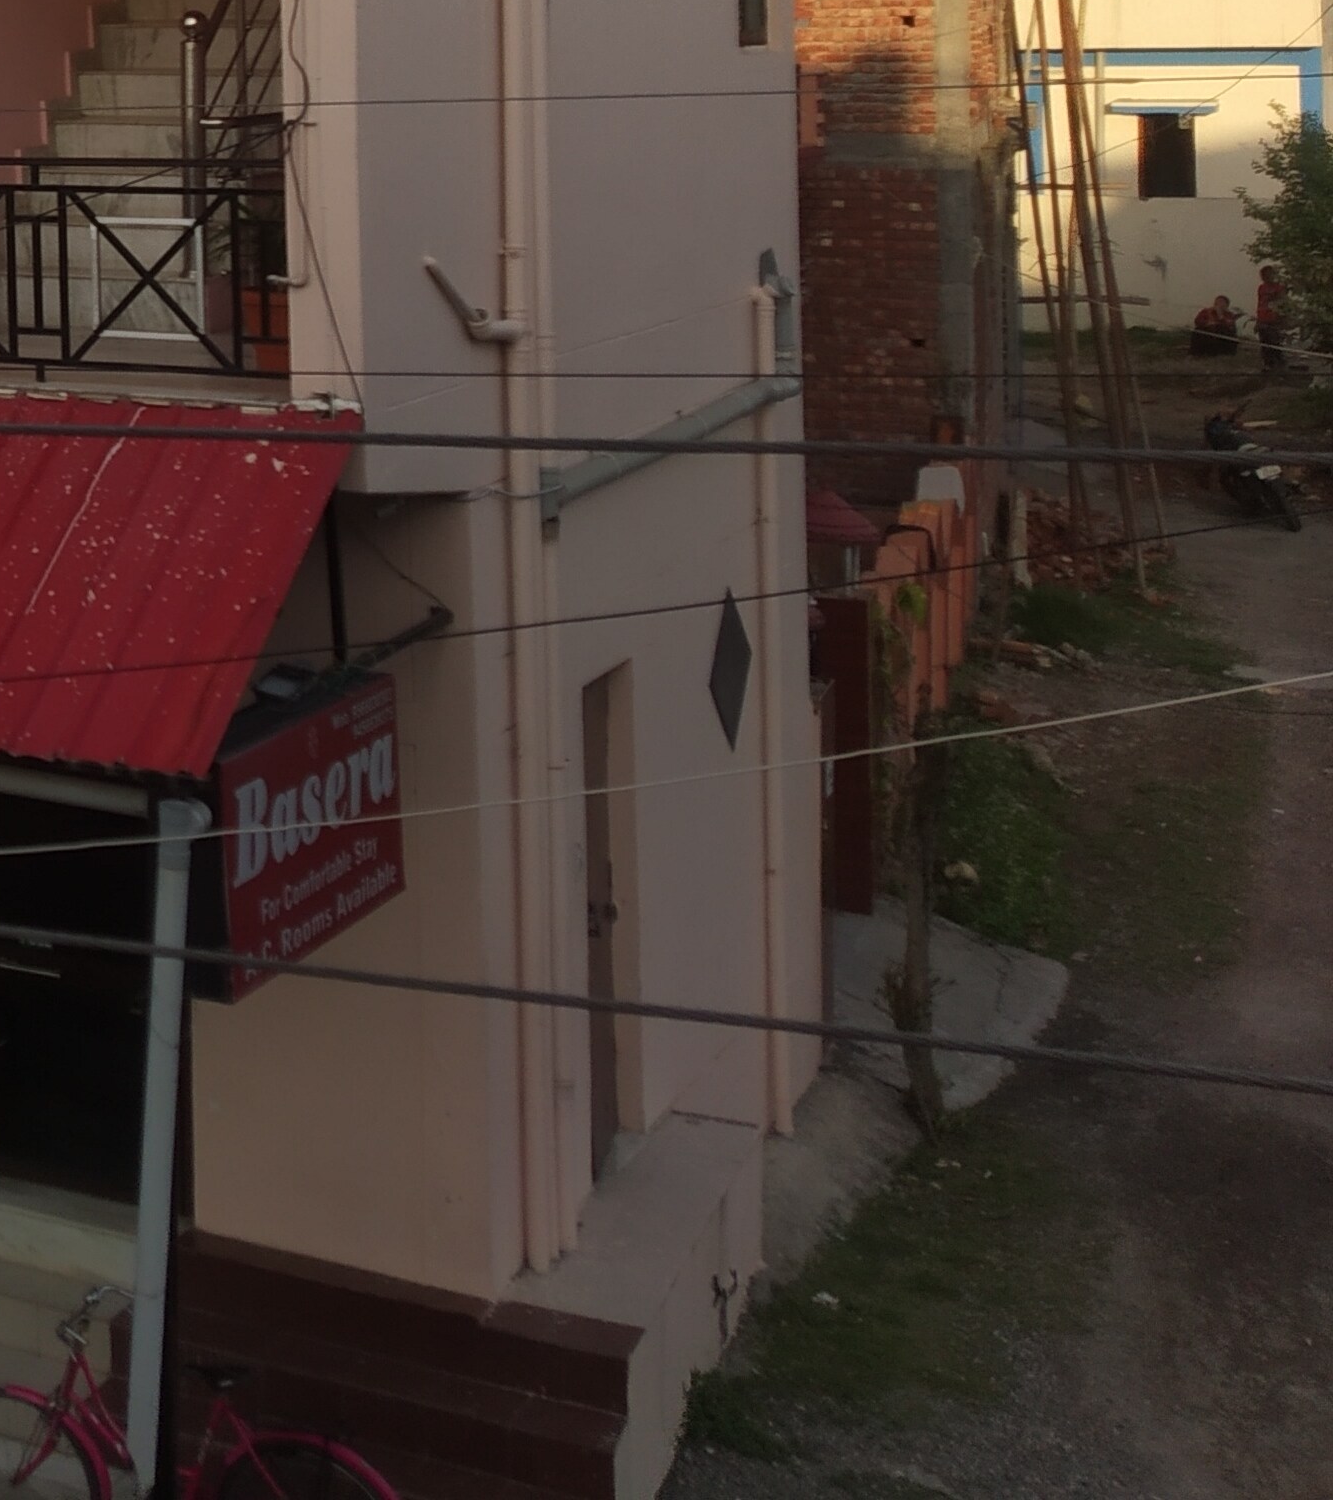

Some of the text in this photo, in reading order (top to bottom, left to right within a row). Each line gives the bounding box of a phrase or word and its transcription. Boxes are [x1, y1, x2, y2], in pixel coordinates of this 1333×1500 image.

[234, 734, 396, 889] Basera
[261, 897, 281, 926] For
[281, 908, 333, 957] Rooms
[336, 861, 397, 920] Available
